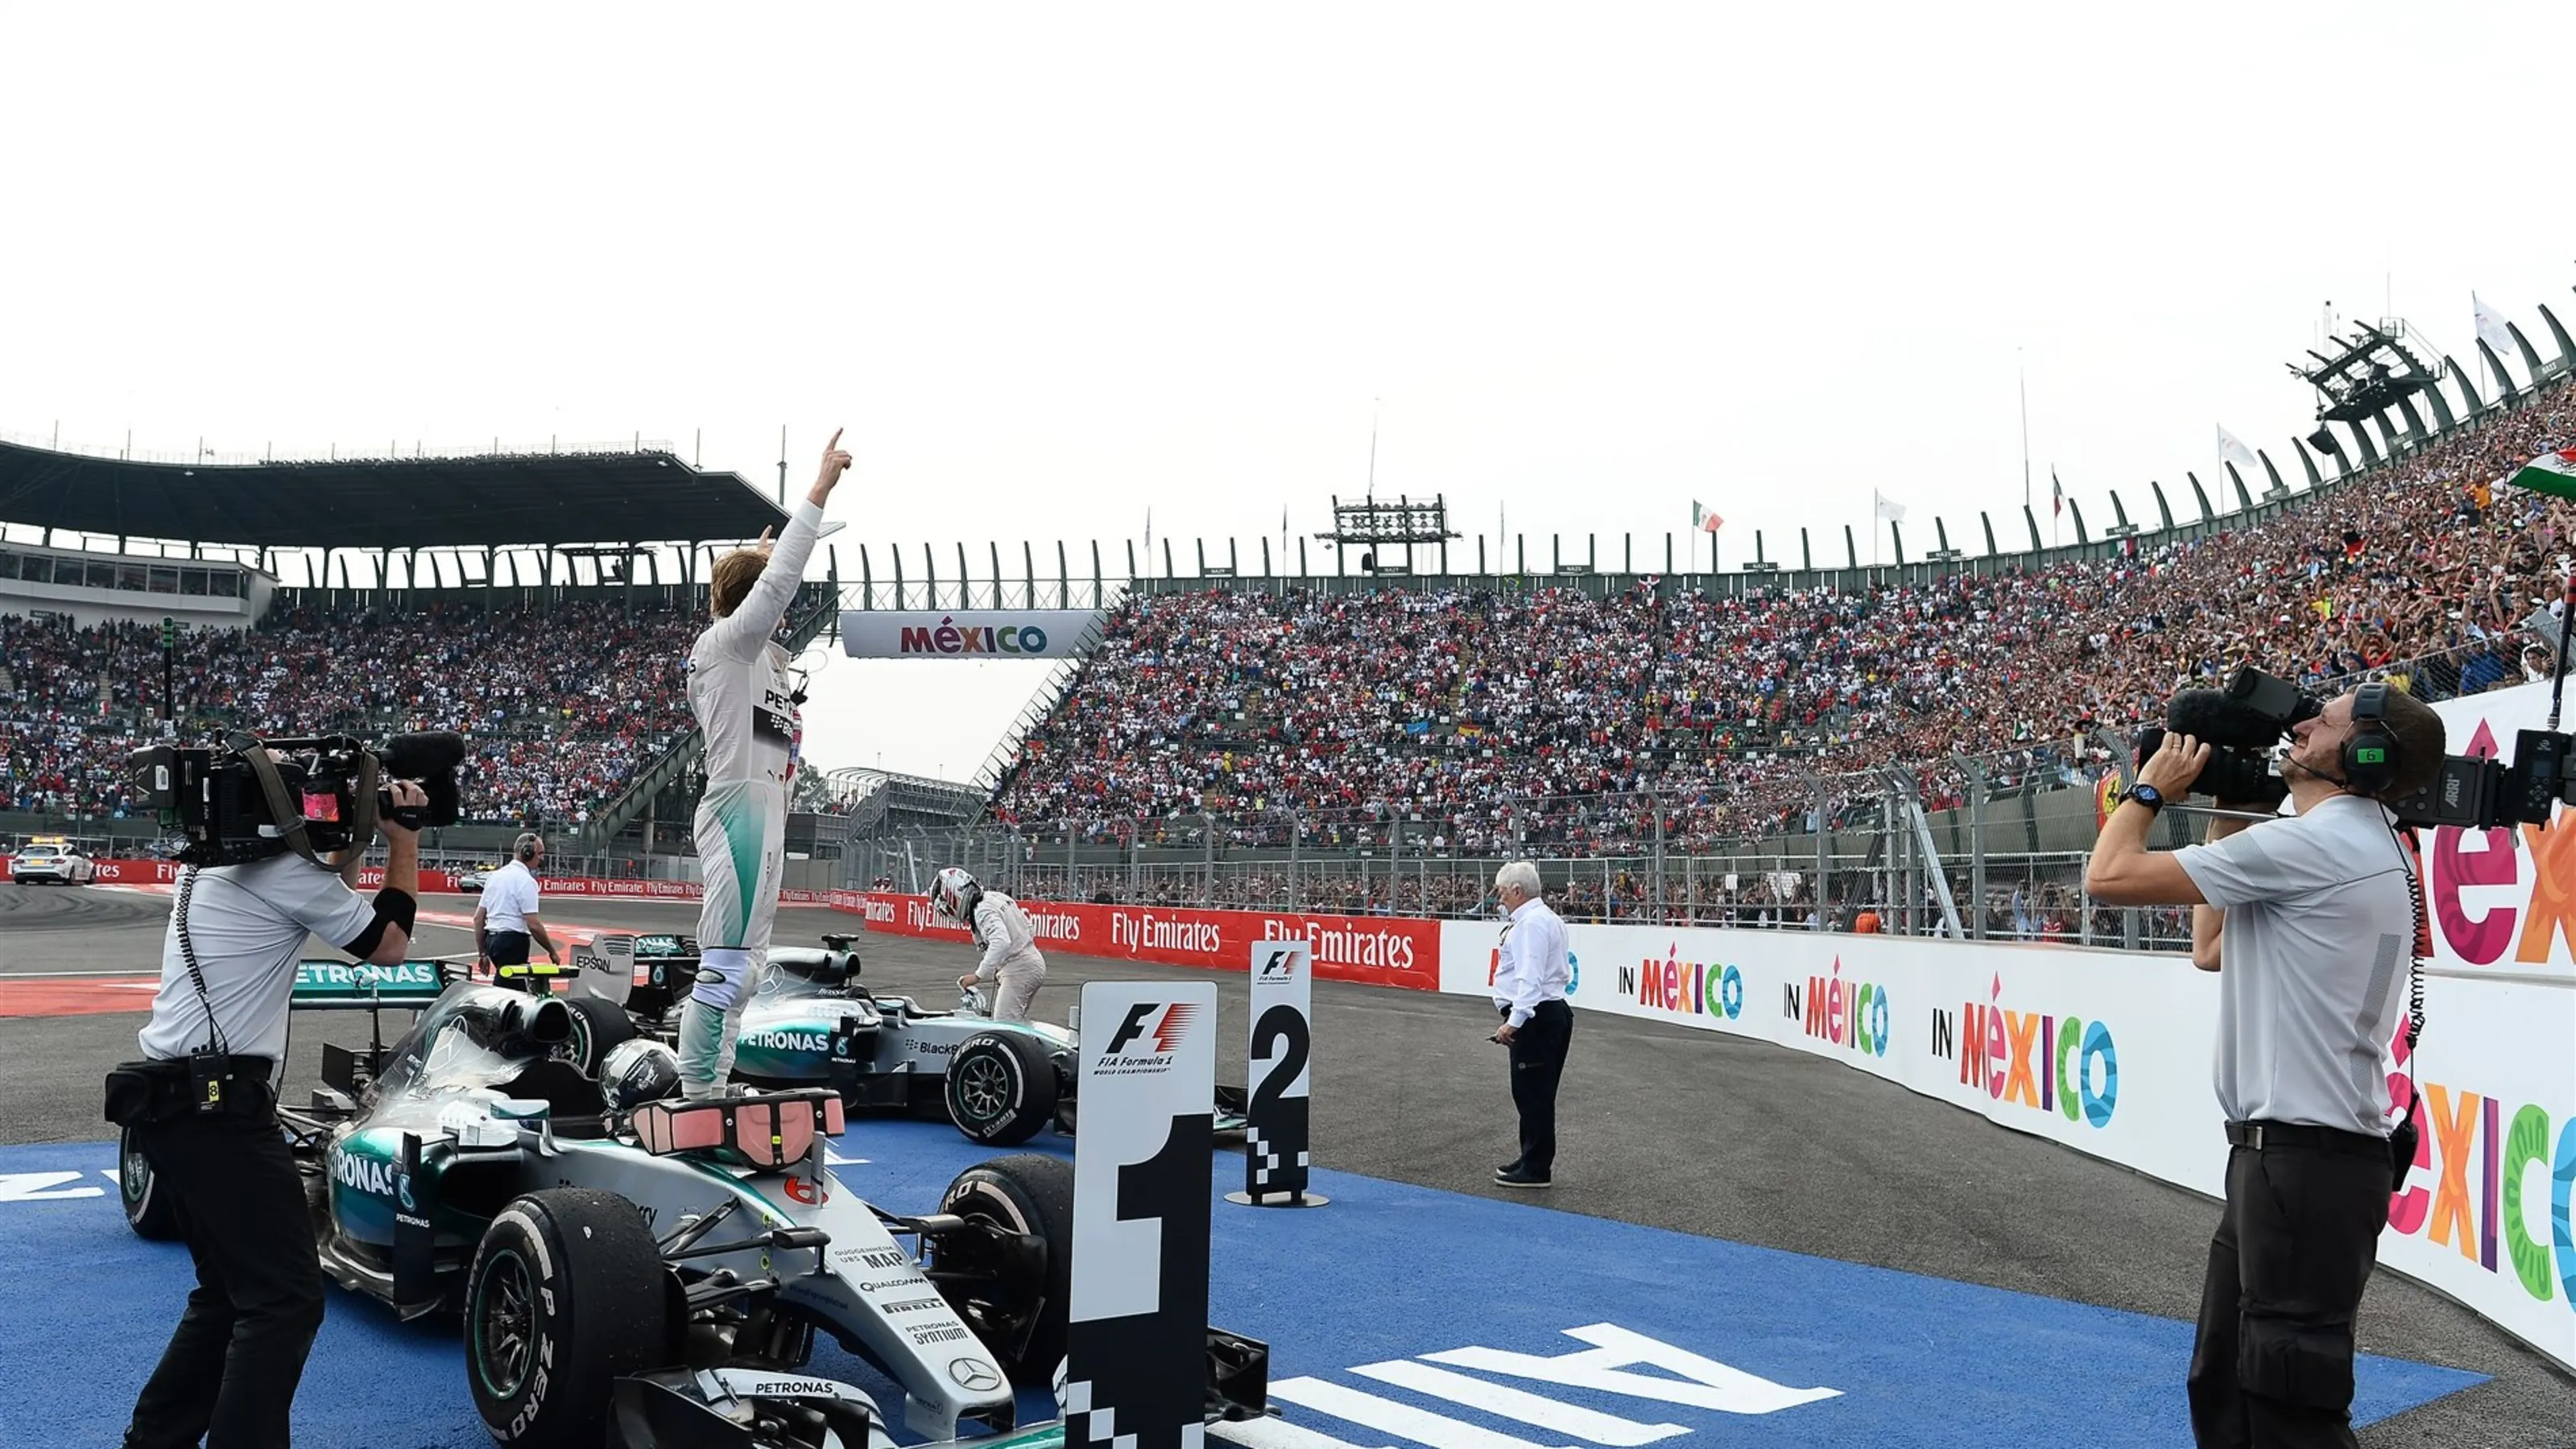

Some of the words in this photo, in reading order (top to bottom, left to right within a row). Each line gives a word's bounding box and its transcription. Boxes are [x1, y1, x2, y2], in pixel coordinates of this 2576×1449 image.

[2366, 750, 2376, 762] 6
[544, 879, 585, 892] Emirates
[907, 900, 926, 932] Fly
[1111, 912, 1139, 952] Fly
[1142, 914, 1220, 952] Emirates
[1306, 922, 1414, 968] Emirates
[576, 955, 610, 973] EPSON
[295, 964, 434, 984] ETRONAS
[1619, 965, 1634, 995] IN
[1784, 981, 1800, 1021] IN
[740, 1032, 829, 1051] PETRONAS
[1932, 1008, 1952, 1060] IN
[1098, 1057, 1118, 1067] FIA
[1119, 1056, 1163, 1067] Formula
[1164, 1055, 1173, 1065] 1
[1247, 1004, 1311, 1115] 2
[209, 1084, 218, 1097] 8
[395, 1213, 431, 1228] PETRONAS
[1116, 1113, 1214, 1319] 1
[862, 1251, 903, 1269] MAP
[540, 1286, 556, 1317] P
[881, 1298, 945, 1315] PIRELLI
[905, 1320, 960, 1333] PETRONAS
[510, 1331, 554, 1439] ZERO
[755, 1381, 834, 1394] PETRONAS
